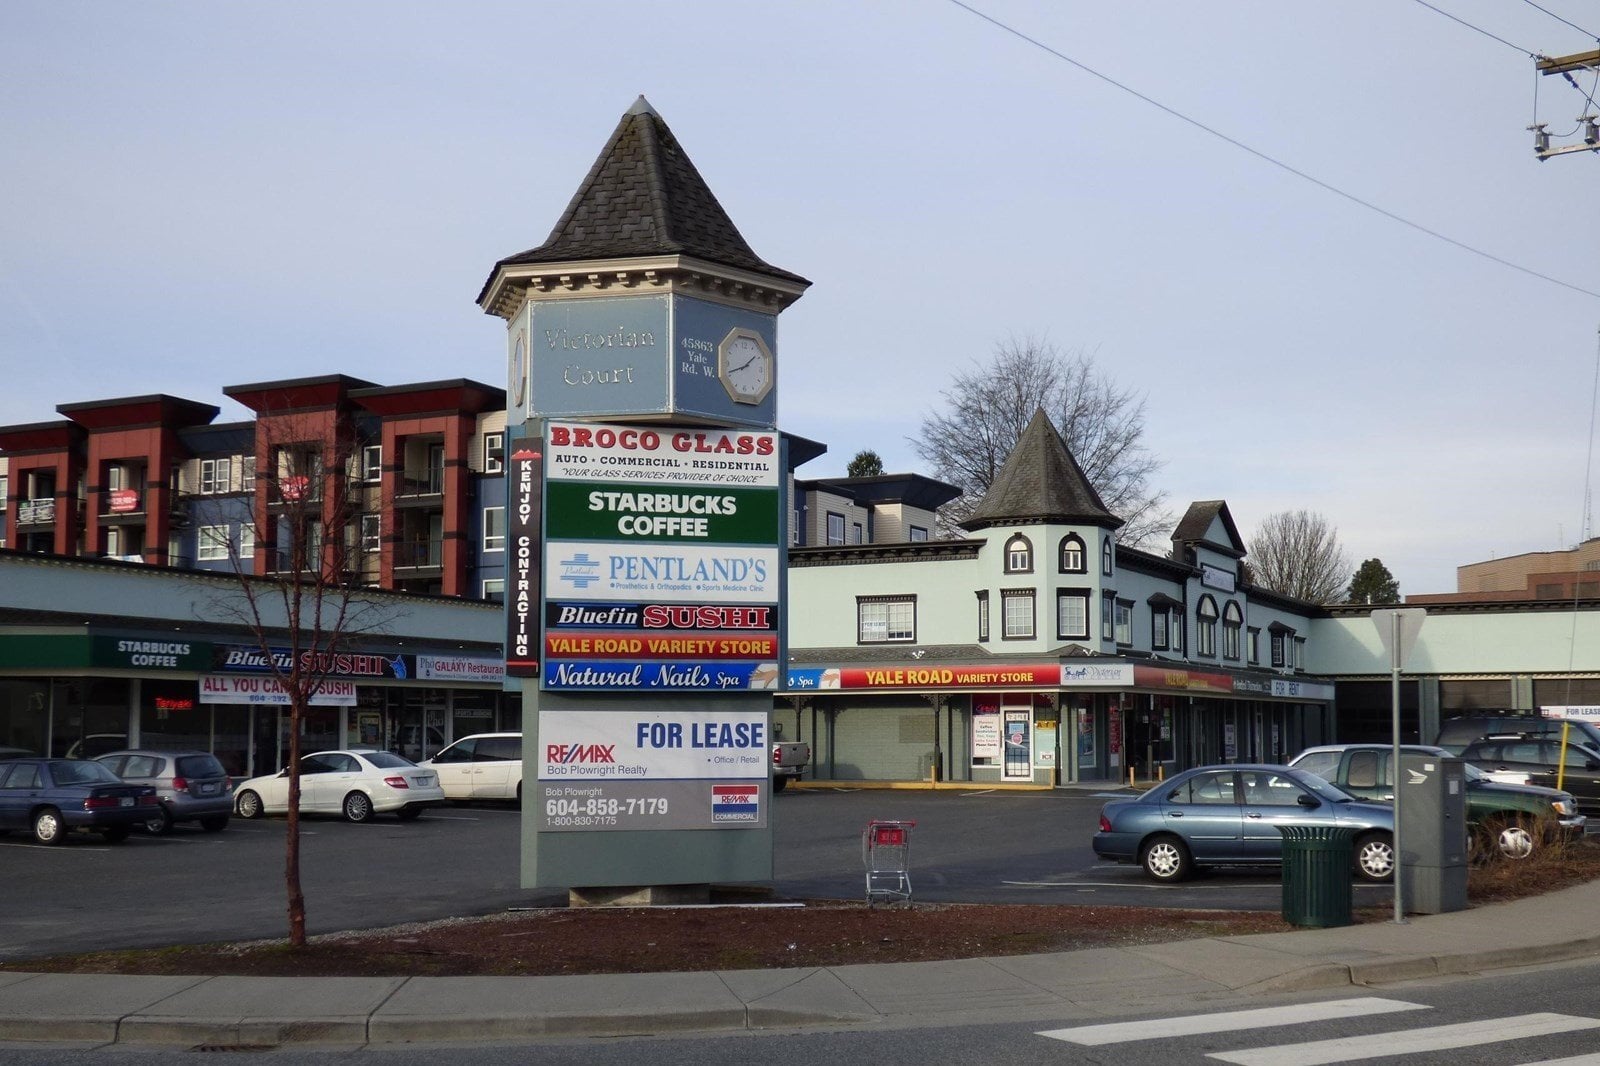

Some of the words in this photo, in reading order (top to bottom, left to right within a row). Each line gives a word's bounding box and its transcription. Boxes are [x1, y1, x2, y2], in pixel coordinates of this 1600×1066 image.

[544, 326, 654, 350] Victorian
[681, 338, 713, 352] 45863
[687, 350, 707, 363] Yale
[564, 364, 634, 386] Court
[682, 362, 698, 374] Rd.
[703, 366, 715, 378] W.
[550, 427, 660, 450] BROCO
[672, 433, 774, 455] GLASS
[556, 454, 587, 463] AUTO
[600, 456, 680, 467] COMMERCIAL
[692, 460, 769, 471] RESIDENTIAL
[591, 469, 620, 477] GLASS
[622, 470, 665, 479] SERVICES
[666, 472, 711, 480] PROVIDER
[519, 460, 532, 525] KENJOY
[588, 491, 736, 515] STARBUCKS
[618, 516, 708, 536] COFFEE
[609, 556, 766, 582] PENTLAND'S
[657, 583, 692, 592] Orthopedics
[516, 536, 530, 656] CONTRACTING
[557, 607, 638, 624] Bluefin
[643, 605, 770, 629] SUSHI
[118, 640, 190, 655] STARBUCKS
[549, 638, 591, 653] YALE
[594, 639, 642, 653] ROAD
[648, 640, 715, 653] VARIETY
[720, 641, 770, 654] STORE
[132, 654, 177, 667] COFFEE
[226, 651, 293, 667] Bluefin
[300, 651, 384, 676] SUSHI
[435, 661, 466, 673] GALAXY
[468, 662, 504, 674] Restauran
[548, 663, 642, 686] Natural
[651, 664, 709, 687] Nails
[716, 673, 740, 686] Spa
[797, 676, 814, 689] Spa
[866, 671, 904, 684] YALE
[908, 670, 953, 684] ROAD
[957, 673, 998, 684] VARIETY
[1000, 673, 1034, 682] STORE
[203, 677, 227, 692] ALL
[233, 678, 258, 692] YOU
[319, 682, 354, 695] SUSHI
[1276, 682, 1284, 695] FOR
[637, 723, 682, 748] FOR
[692, 723, 764, 748] LEASE
[547, 744, 616, 764] RE/MAX
[547, 766, 567, 775] Bob
[570, 765, 615, 776] Plowright
[618, 765, 647, 776] Realty
[546, 788, 562, 796] Bob
[565, 788, 602, 797] Plowright
[721, 796, 749, 804] RE/MAX
[546, 798, 668, 816] 604-858-7179
[546, 816, 616, 826] 1-800-830-7175
